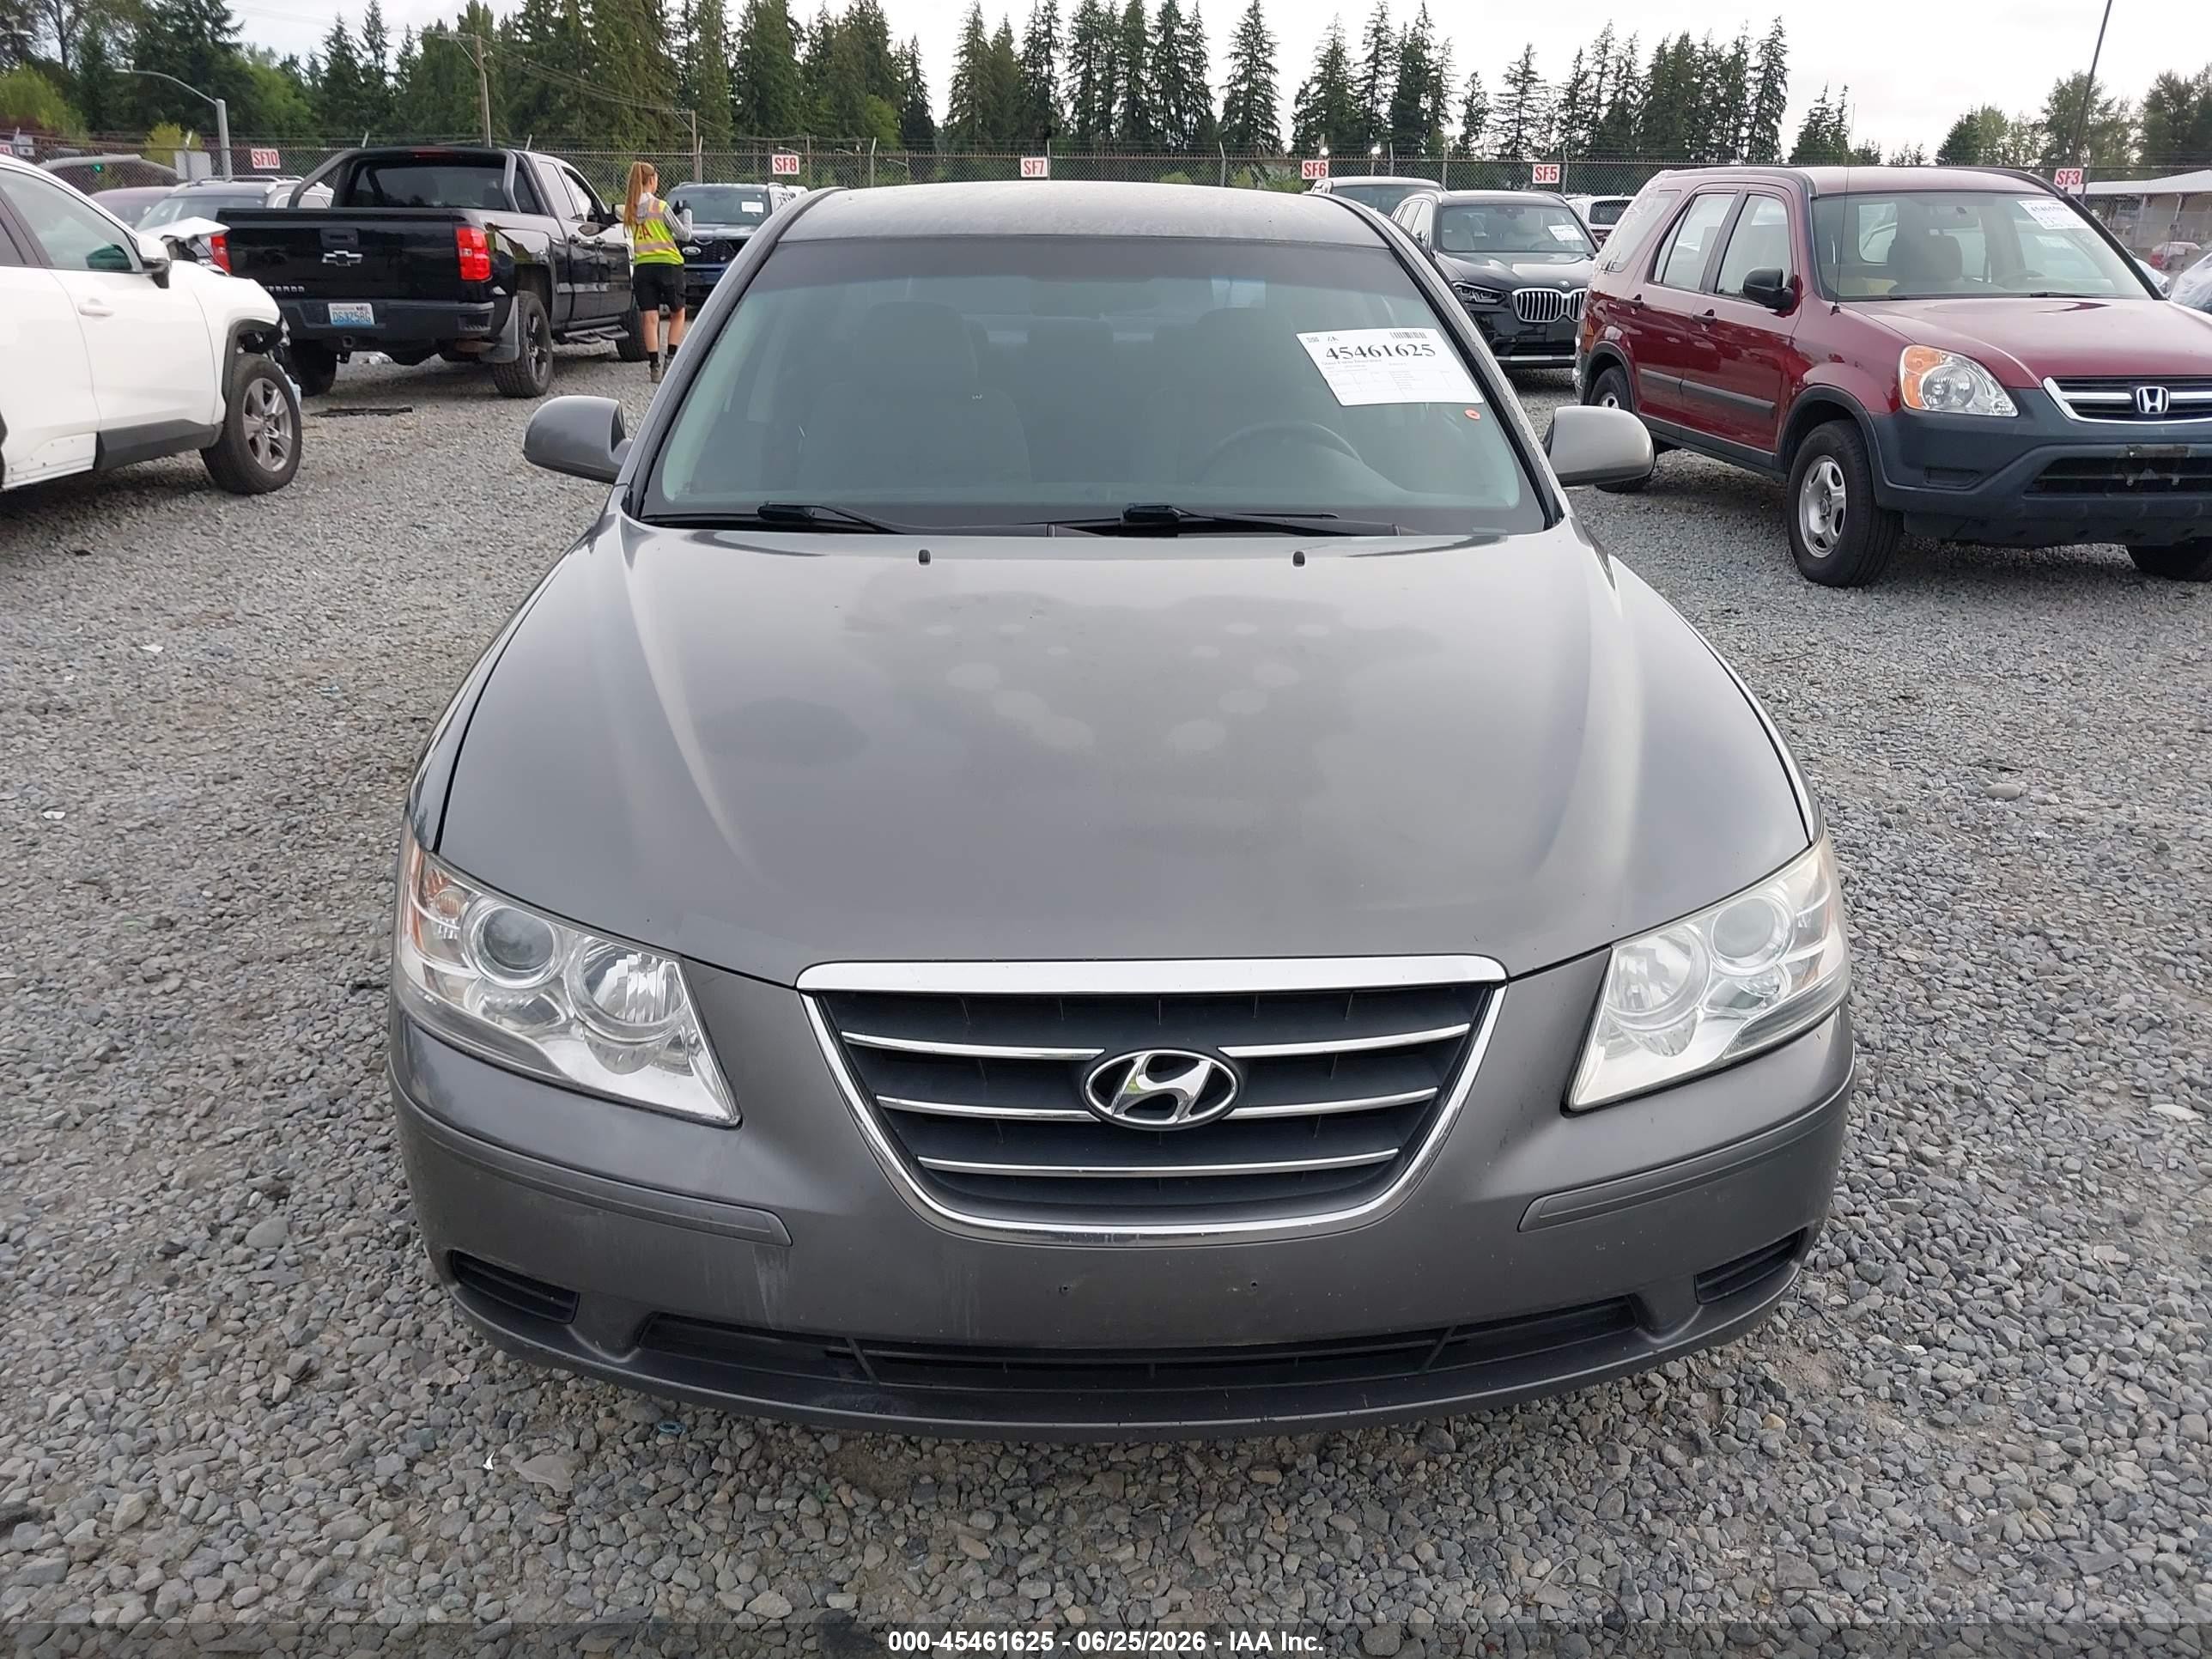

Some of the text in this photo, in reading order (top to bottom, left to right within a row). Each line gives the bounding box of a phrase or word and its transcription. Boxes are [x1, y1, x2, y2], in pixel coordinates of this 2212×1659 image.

[252, 150, 278, 166] SF10
[775, 157, 797, 172] SF8
[1024, 160, 1044, 175] SF7
[1304, 162, 1327, 177] SF6
[1534, 166, 1558, 181] SF5
[2057, 170, 2080, 185] SF3
[1326, 343, 1437, 360] 45461625
